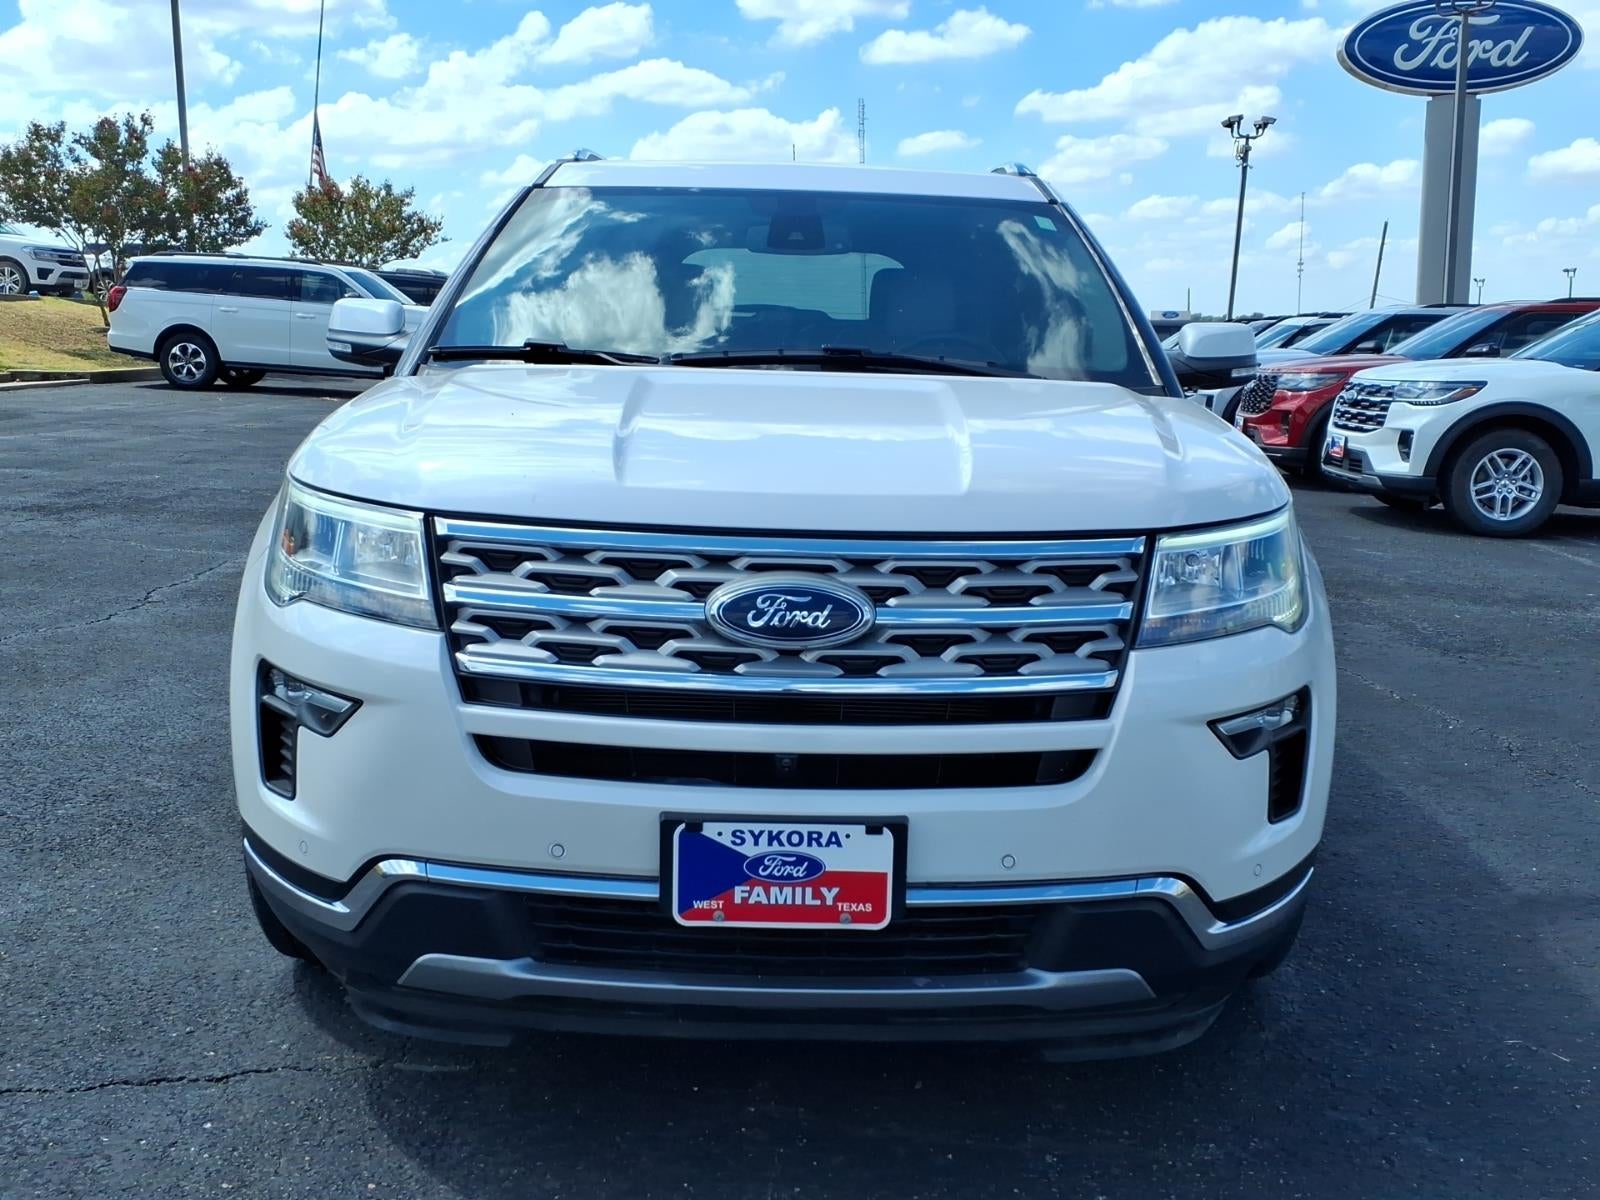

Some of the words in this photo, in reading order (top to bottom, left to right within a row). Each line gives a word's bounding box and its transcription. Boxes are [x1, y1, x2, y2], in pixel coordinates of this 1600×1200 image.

[1393, 14, 1535, 71] Ford
[747, 593, 833, 629] Ford
[730, 829, 843, 848] SYKORA
[758, 854, 808, 878] Ford
[692, 899, 725, 910] WEST
[836, 902, 873, 912] TEXAS
[733, 885, 840, 906] FAMILY
